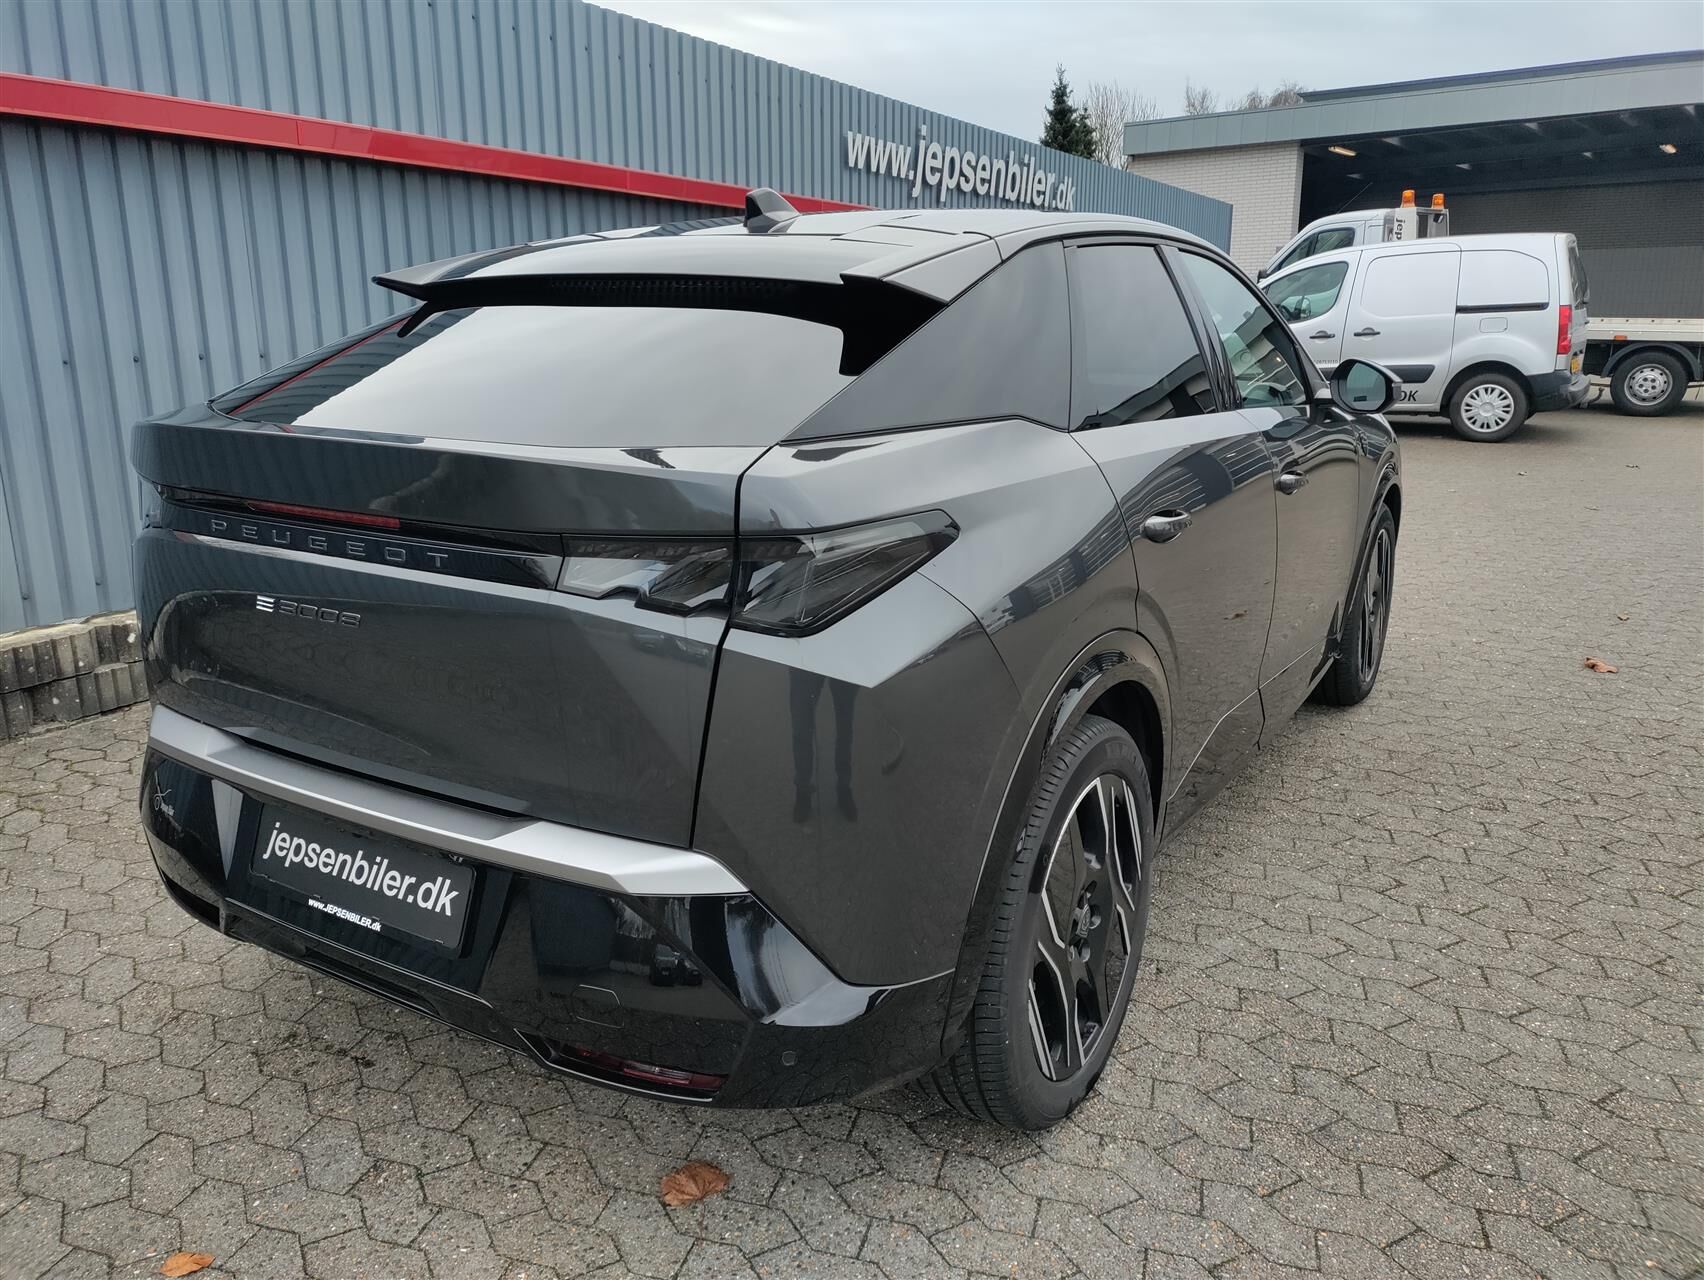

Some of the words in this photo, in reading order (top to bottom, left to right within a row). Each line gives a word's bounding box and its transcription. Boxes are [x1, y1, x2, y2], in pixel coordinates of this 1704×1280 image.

[847, 124, 1076, 211] www.jepsenbiler.dk
[210, 519, 448, 568] PEUGEOT
[262, 822, 459, 917] jepsenbiler.dk
[308, 898, 382, 932] www.JEPSENBILER.dk
